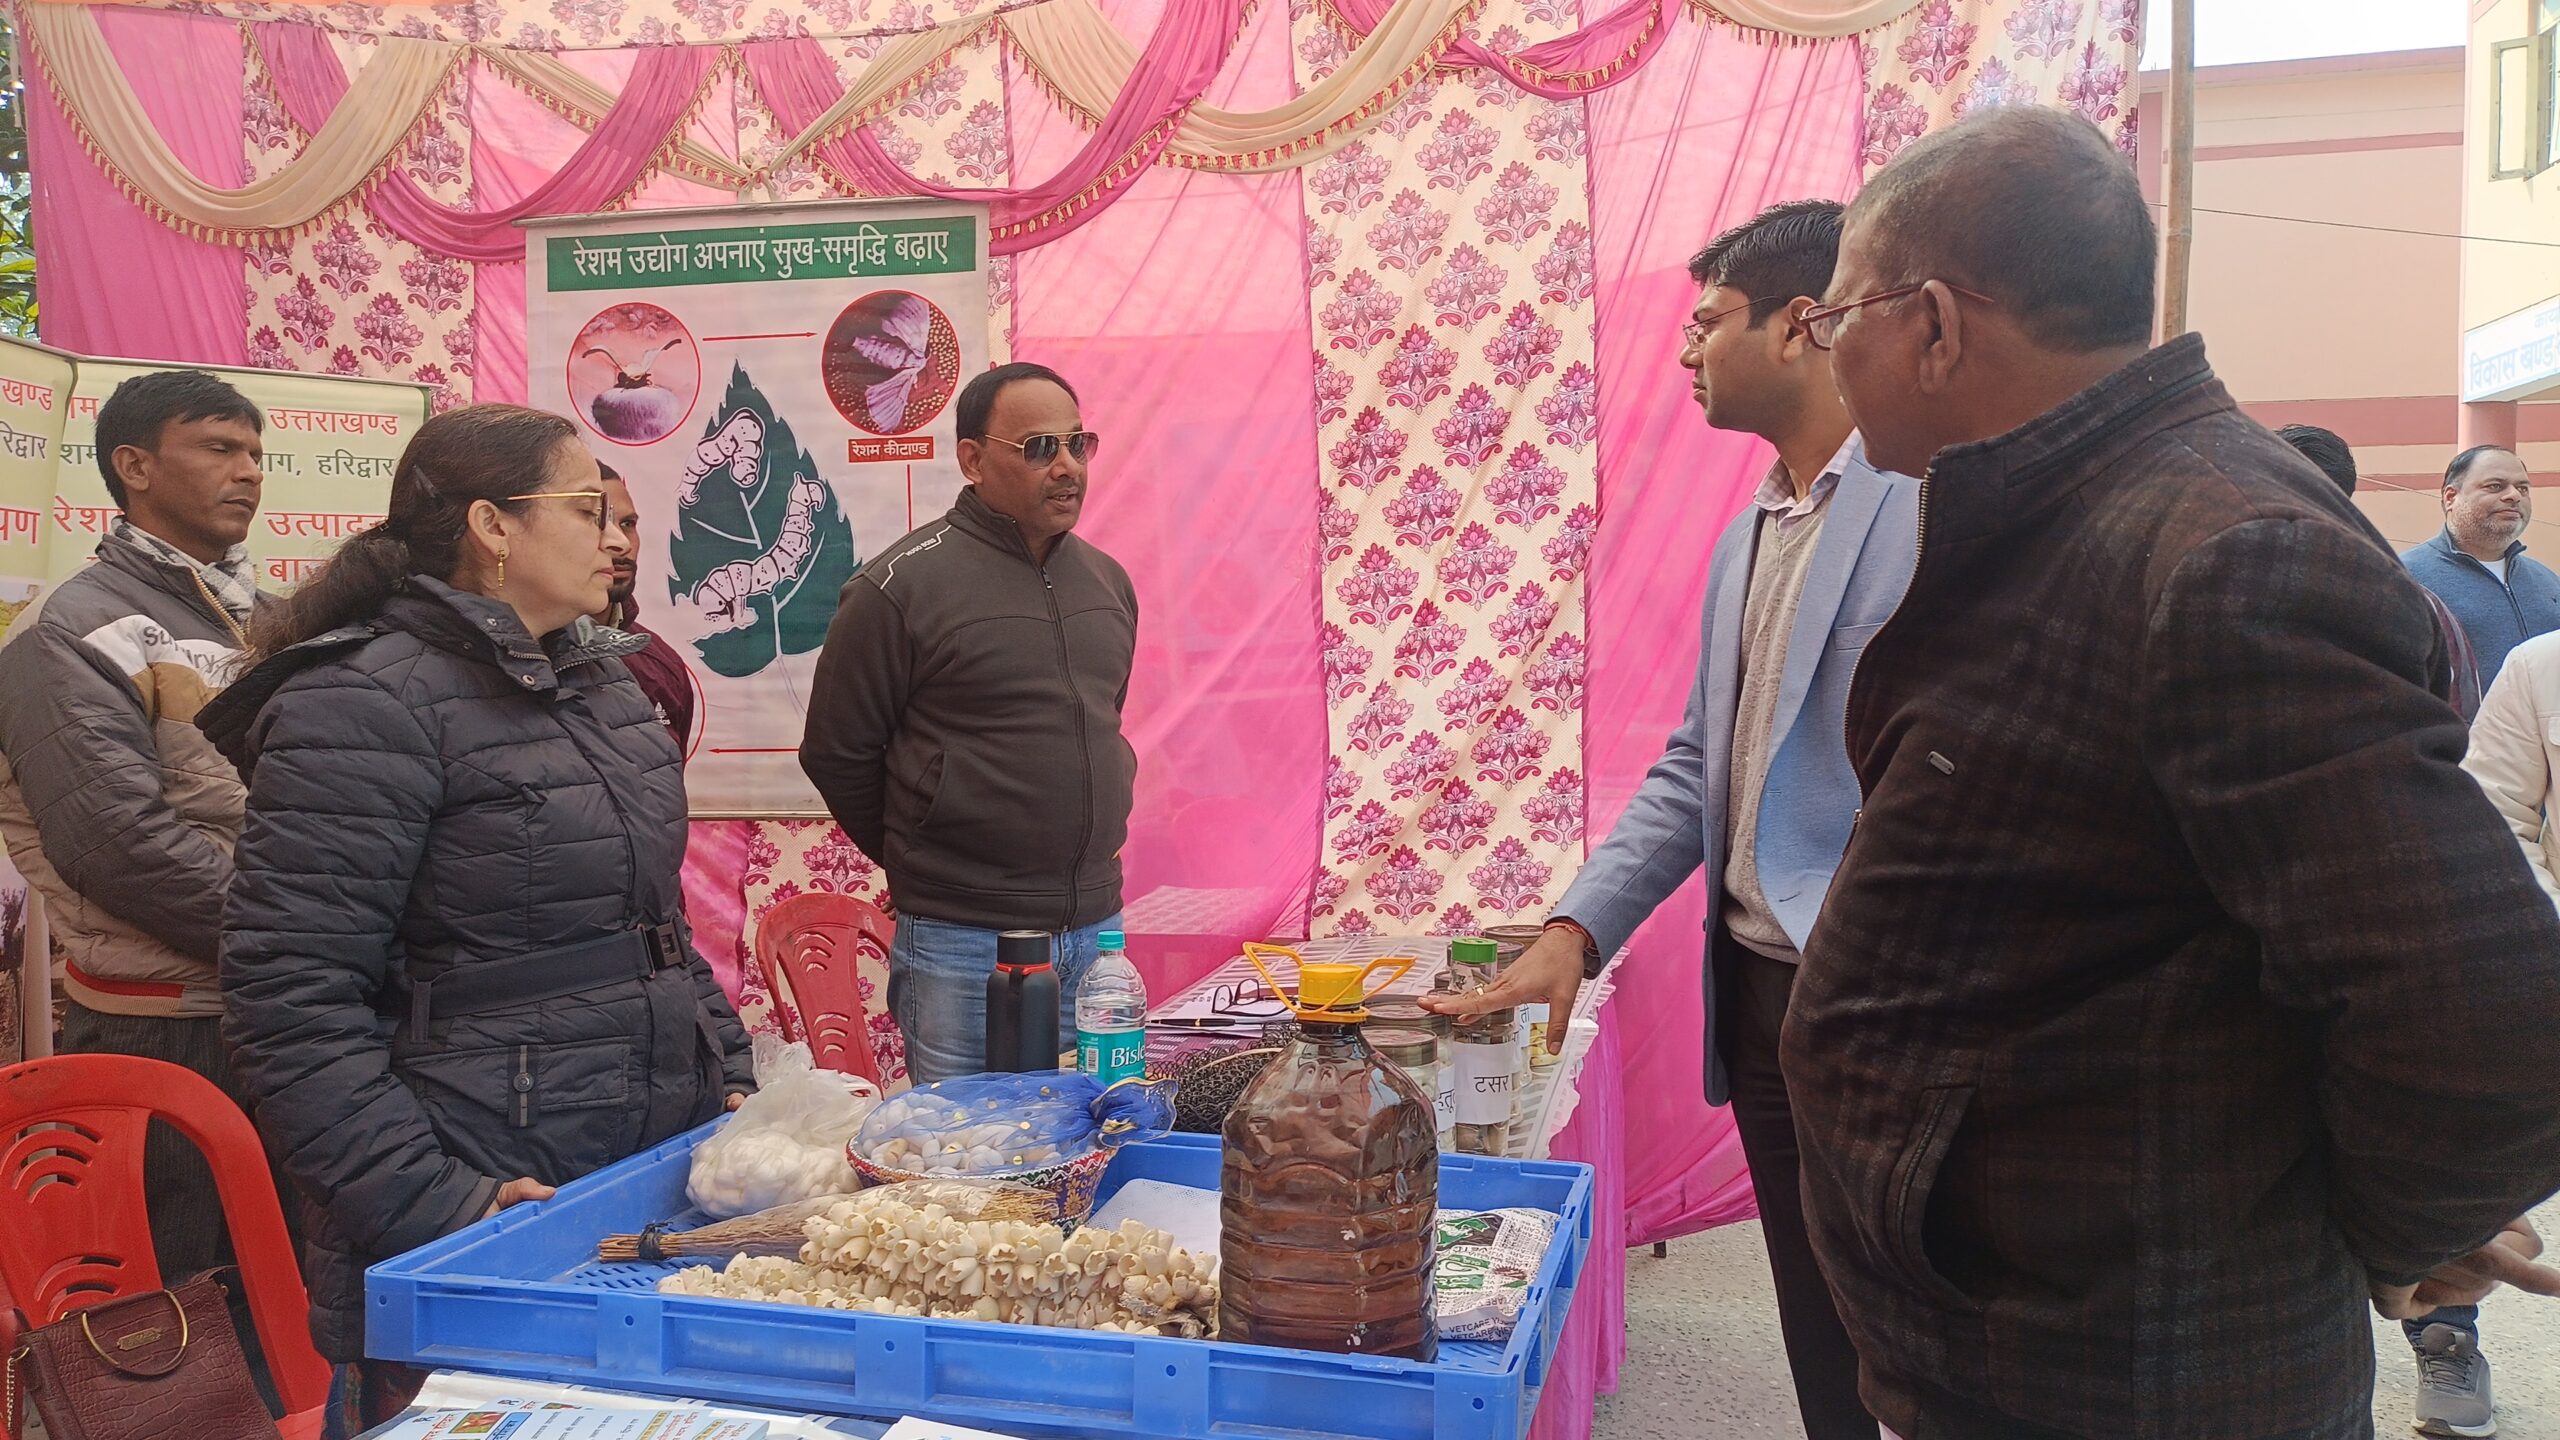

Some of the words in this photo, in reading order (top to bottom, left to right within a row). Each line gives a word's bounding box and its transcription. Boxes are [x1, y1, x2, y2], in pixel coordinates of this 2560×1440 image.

[573, 238, 622, 276] रेशम
[626, 233, 689, 275] उद्योग
[693, 227, 767, 273] अपनाएं
[771, 223, 888, 278] सुख-समृद्धि
[893, 231, 949, 266] बढ़ाए
[2470, 349, 2518, 391] विकास
[2520, 333, 2555, 372] खण्ड
[0, 377, 54, 411] खण्ड
[267, 408, 399, 435] उत्तराखण्ड
[0, 420, 48, 460] रिद्वार
[851, 440, 881, 457] रेशम
[883, 439, 930, 456] कीटाण्ड
[315, 448, 395, 479] हरिद्वार
[53, 495, 125, 533] रेश
[1111, 1040, 1146, 1068] Bisle
[1473, 1075, 1509, 1094] टसर
[1448, 1317, 1490, 1333] VETCARE
